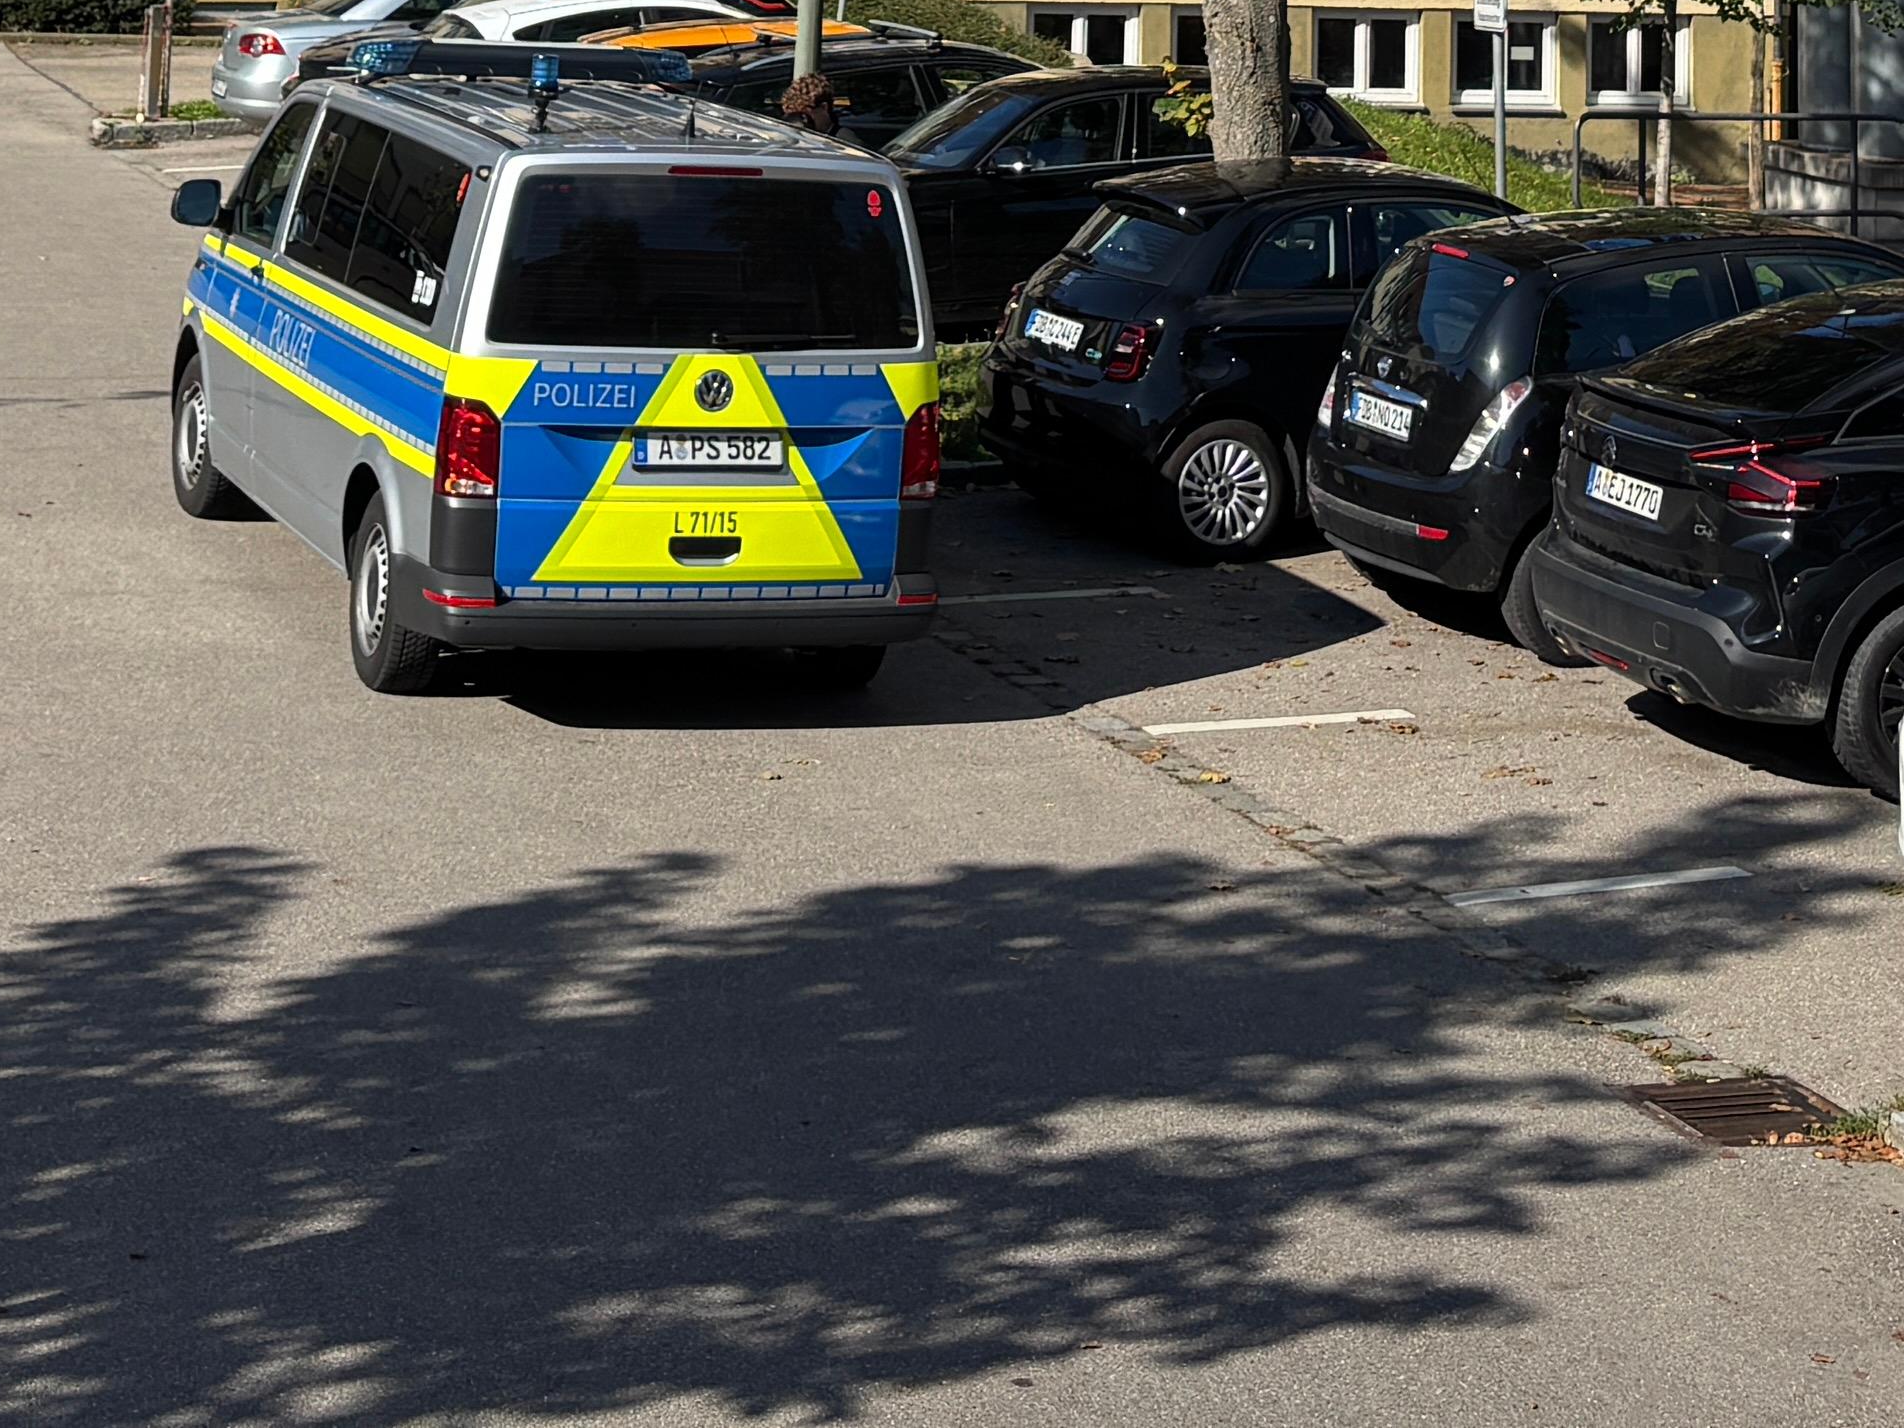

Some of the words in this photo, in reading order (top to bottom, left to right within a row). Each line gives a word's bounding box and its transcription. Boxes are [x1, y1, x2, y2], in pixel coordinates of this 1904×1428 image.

[269, 308, 317, 370] POLIZEI
[533, 382, 636, 409] POLIZEI
[691, 435, 721, 460] PS
[727, 435, 772, 460] 582
[1625, 482, 1659, 515] 1770
[674, 511, 685, 533] L
[690, 511, 738, 534] 71/15
